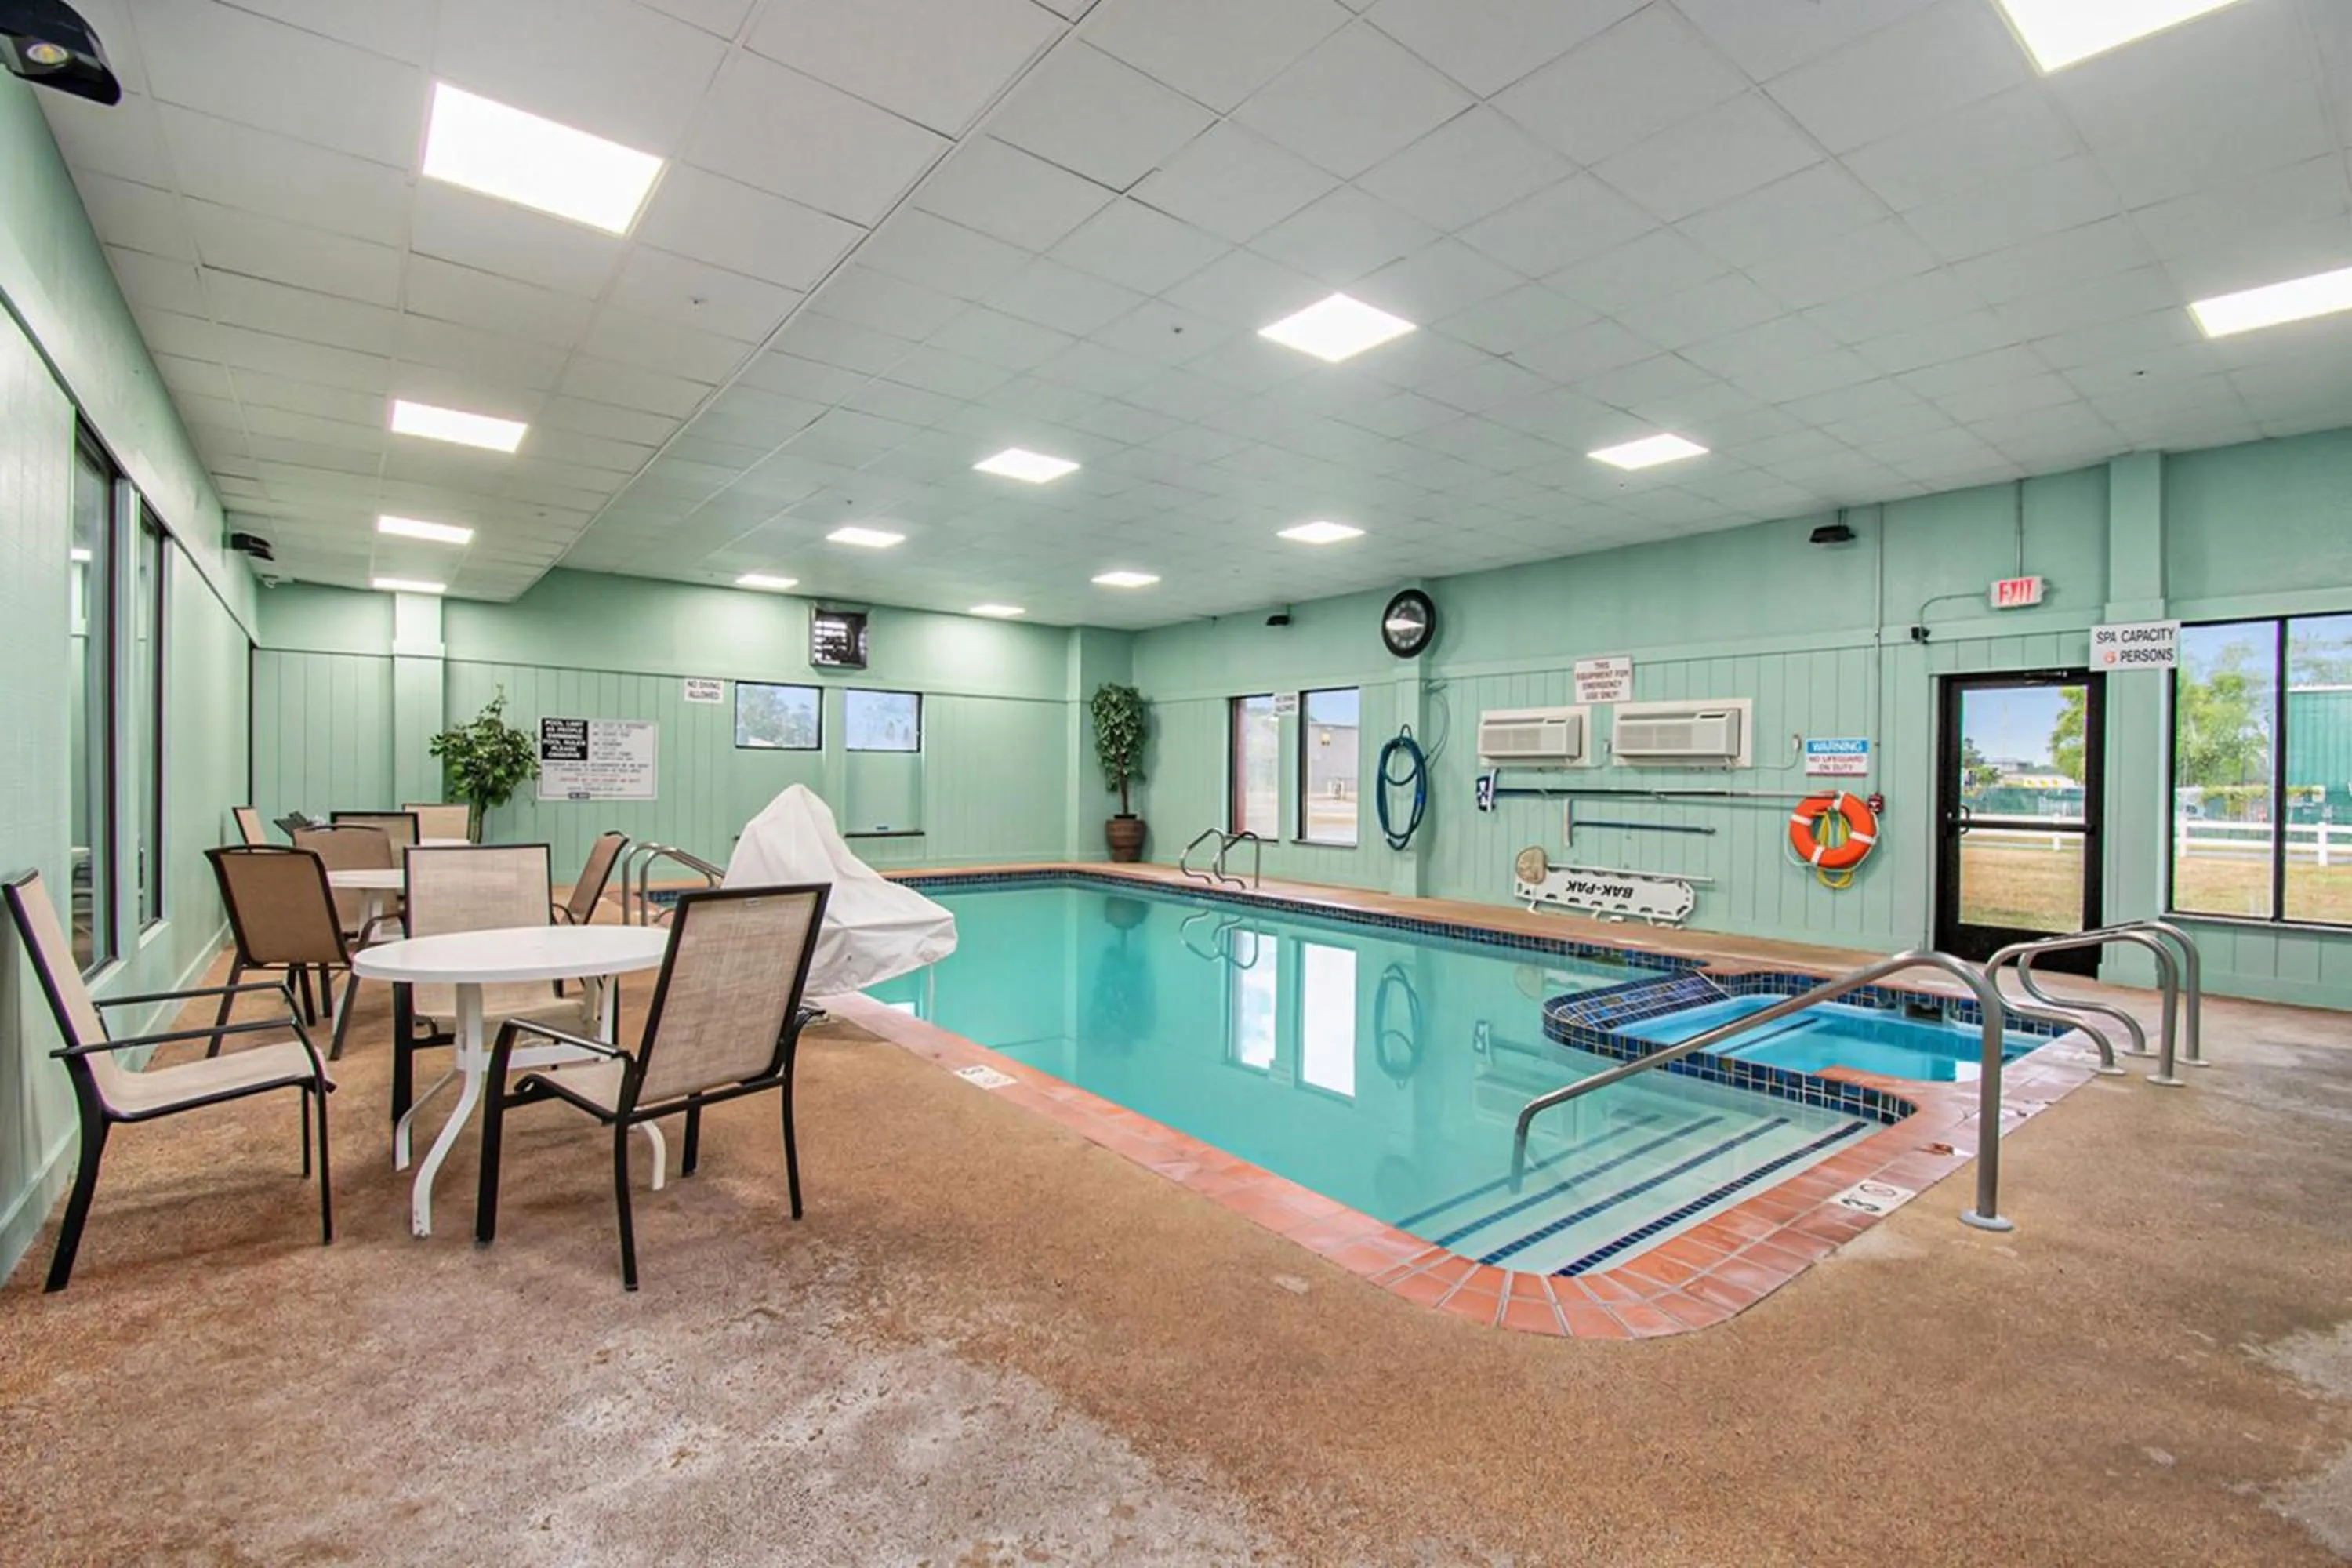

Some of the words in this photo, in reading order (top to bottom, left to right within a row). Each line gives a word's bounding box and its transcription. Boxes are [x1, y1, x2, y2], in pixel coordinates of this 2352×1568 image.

[1998, 579, 2034, 604] EXIT
[2096, 630, 2117, 644] SPA
[2121, 627, 2174, 643] CAPACITY
[2120, 648, 2174, 664] PERSONS
[1576, 669, 1613, 681] EQUIPMENT
[688, 680, 697, 688] NO
[1582, 680, 1622, 691] EMERGENCY
[688, 689, 720, 700] ALLOWED
[1585, 691, 1598, 700] USE
[1812, 739, 1862, 752] WARNING
[1821, 755, 1864, 764] LIFEGUARD
[1833, 763, 1853, 771] DUTY
[1566, 880, 1634, 898] BAK-PAK
